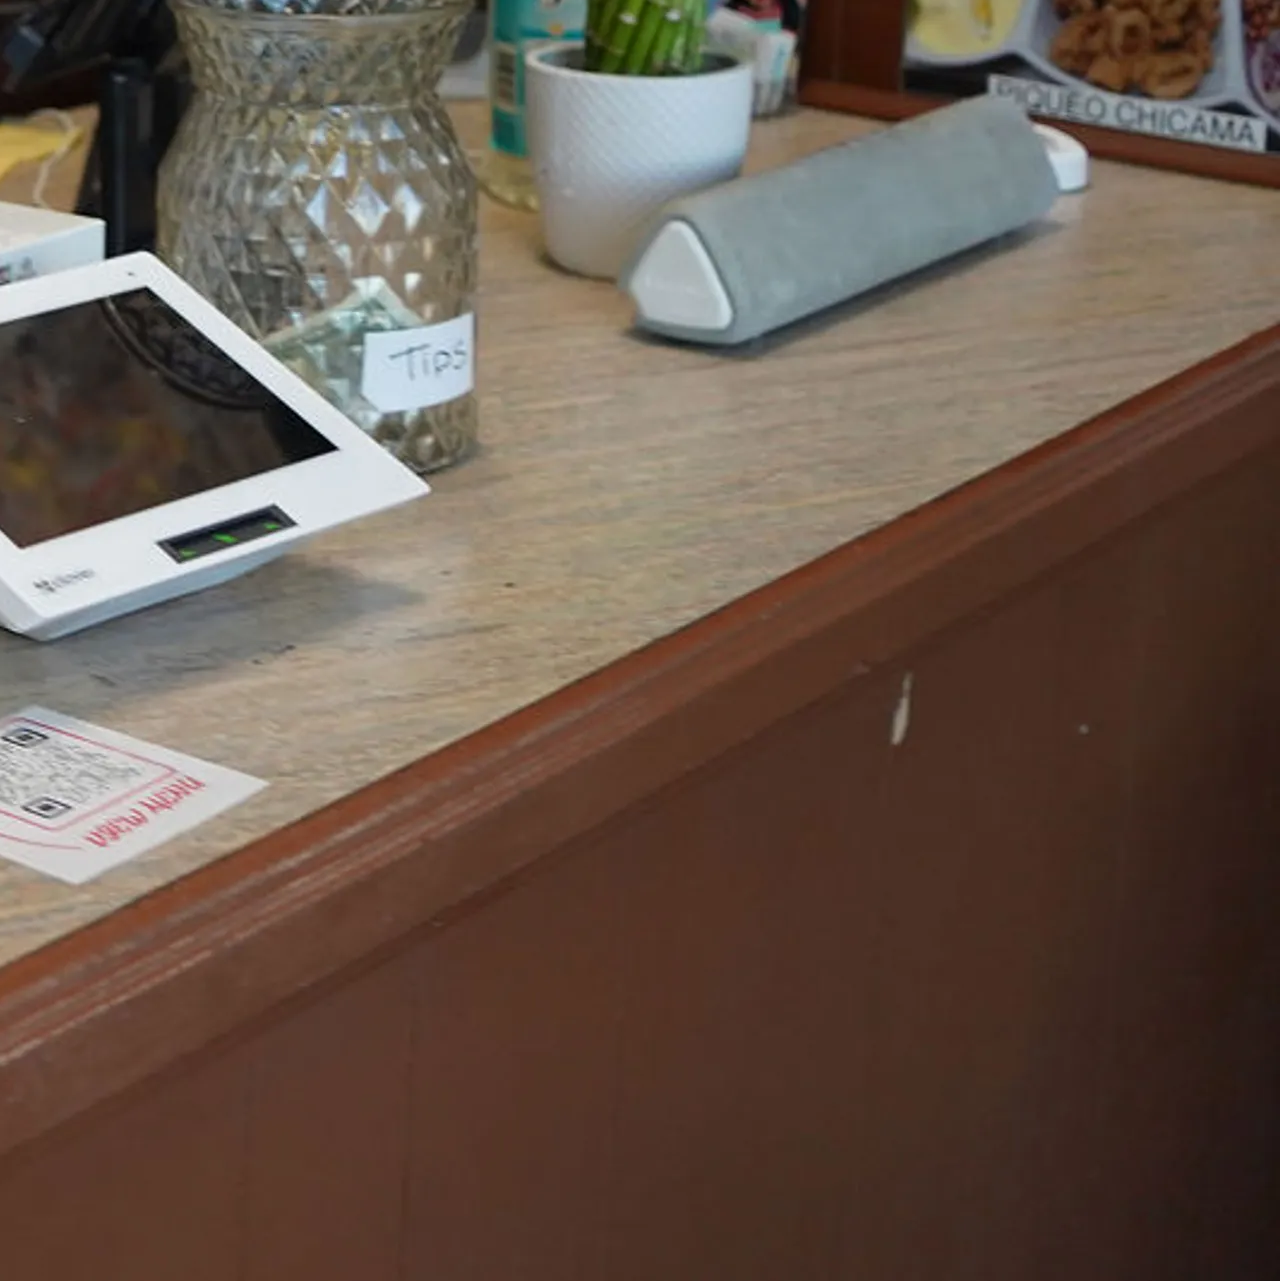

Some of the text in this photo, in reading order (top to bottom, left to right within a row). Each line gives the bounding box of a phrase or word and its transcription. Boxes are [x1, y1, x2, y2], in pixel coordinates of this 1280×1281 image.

[997, 79, 1257, 146] PIQUEO CHICAMA
[388, 340, 466, 381] Tips
